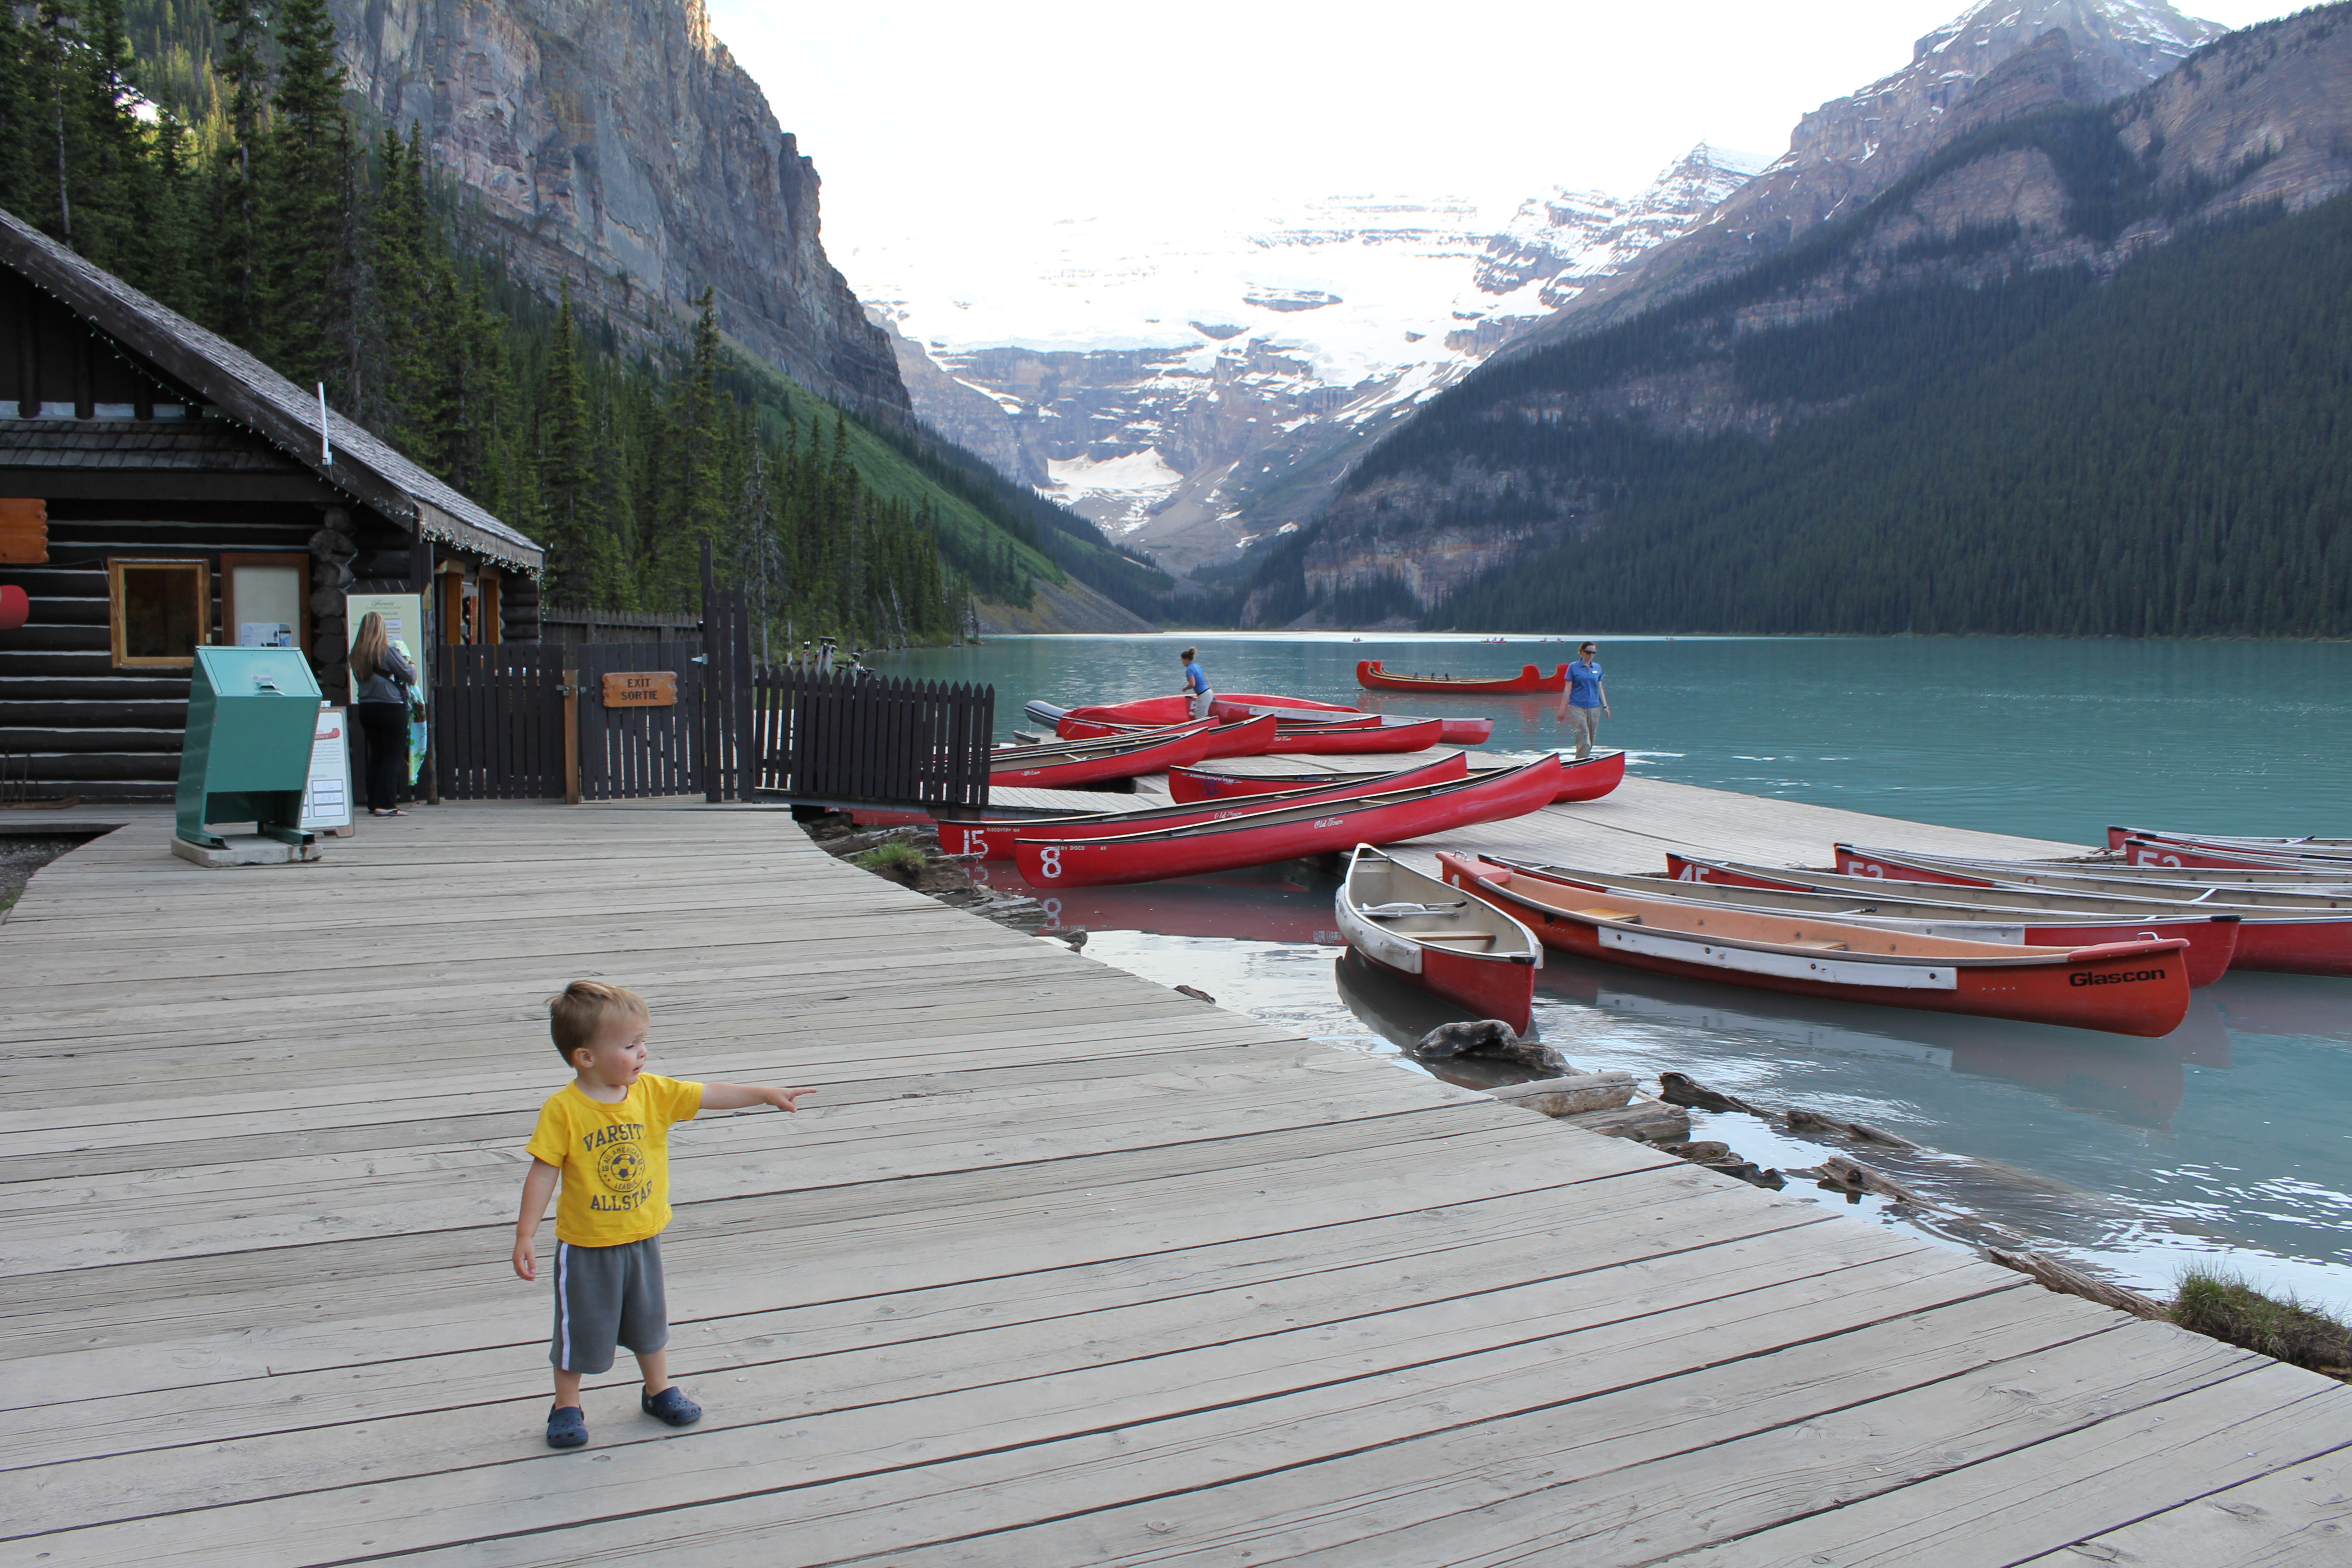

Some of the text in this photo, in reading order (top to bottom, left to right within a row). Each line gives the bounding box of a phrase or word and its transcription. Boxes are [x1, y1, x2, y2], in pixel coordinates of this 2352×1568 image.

[627, 678, 651, 688] EXIT
[621, 691, 657, 701] SORTIE
[1314, 818, 1343, 829] Old Town
[964, 829, 989, 855] 15
[1040, 846, 1062, 878] 8
[2069, 969, 2166, 987] Glascon
